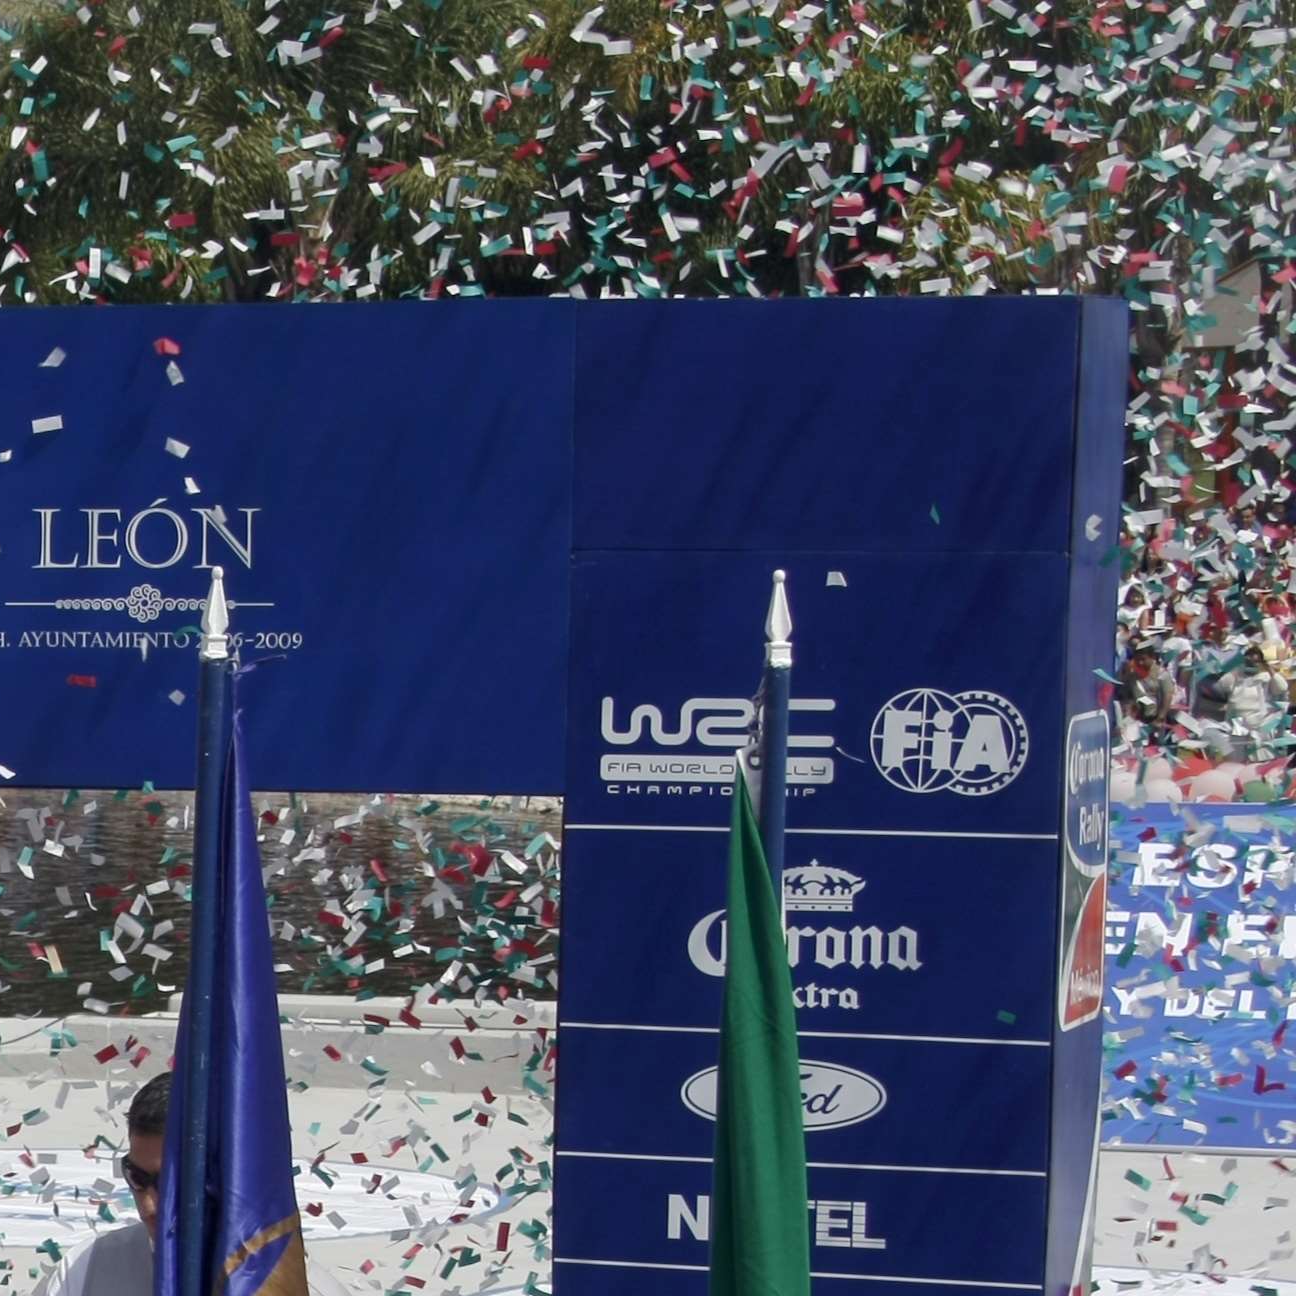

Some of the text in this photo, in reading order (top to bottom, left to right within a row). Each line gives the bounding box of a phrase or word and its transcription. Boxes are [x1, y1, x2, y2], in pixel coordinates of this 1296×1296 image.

[19, 631, 189, 649] AYUNTAMIENTO
[601, 696, 836, 747] WRC
[881, 709, 1011, 773] FIA
[608, 762, 735, 775] FIA WORLD
[1079, 804, 1104, 851] Rally
